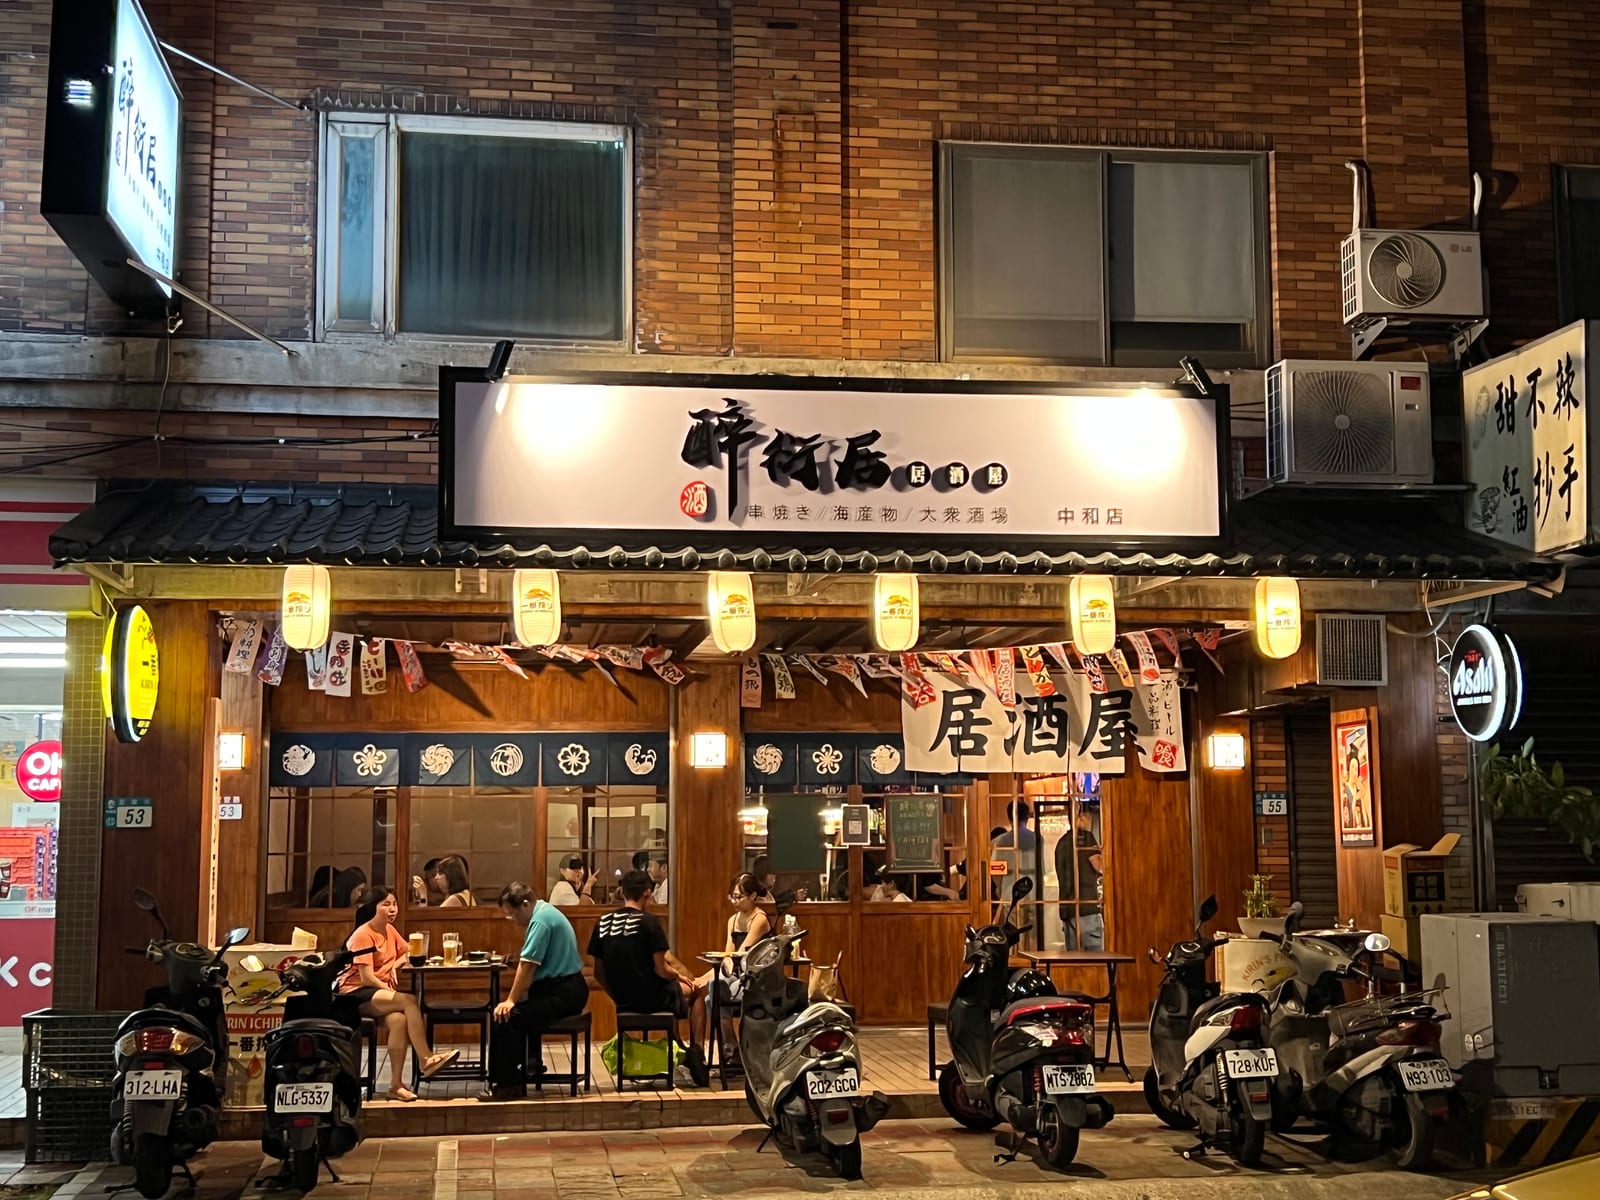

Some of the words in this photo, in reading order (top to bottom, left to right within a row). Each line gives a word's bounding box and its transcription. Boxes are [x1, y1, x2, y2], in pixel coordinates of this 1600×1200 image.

[1494, 352, 1580, 435] 甜不辣
[908, 463, 1005, 487] 居酒屋
[1533, 443, 1579, 534] 抄手
[1057, 507, 1123, 526] 中和店
[1453, 656, 1494, 696] Asahi
[929, 689, 1147, 760] 居酒屋
[27, 778, 61, 791] CAF
[219, 806, 235, 818] 53
[1268, 800, 1282, 813] 55
[125, 808, 146, 825] 53
[226, 1016, 247, 1029] RIN
[125, 1080, 179, 1096] 312-LHA
[276, 1090, 330, 1107] NLG-5337
